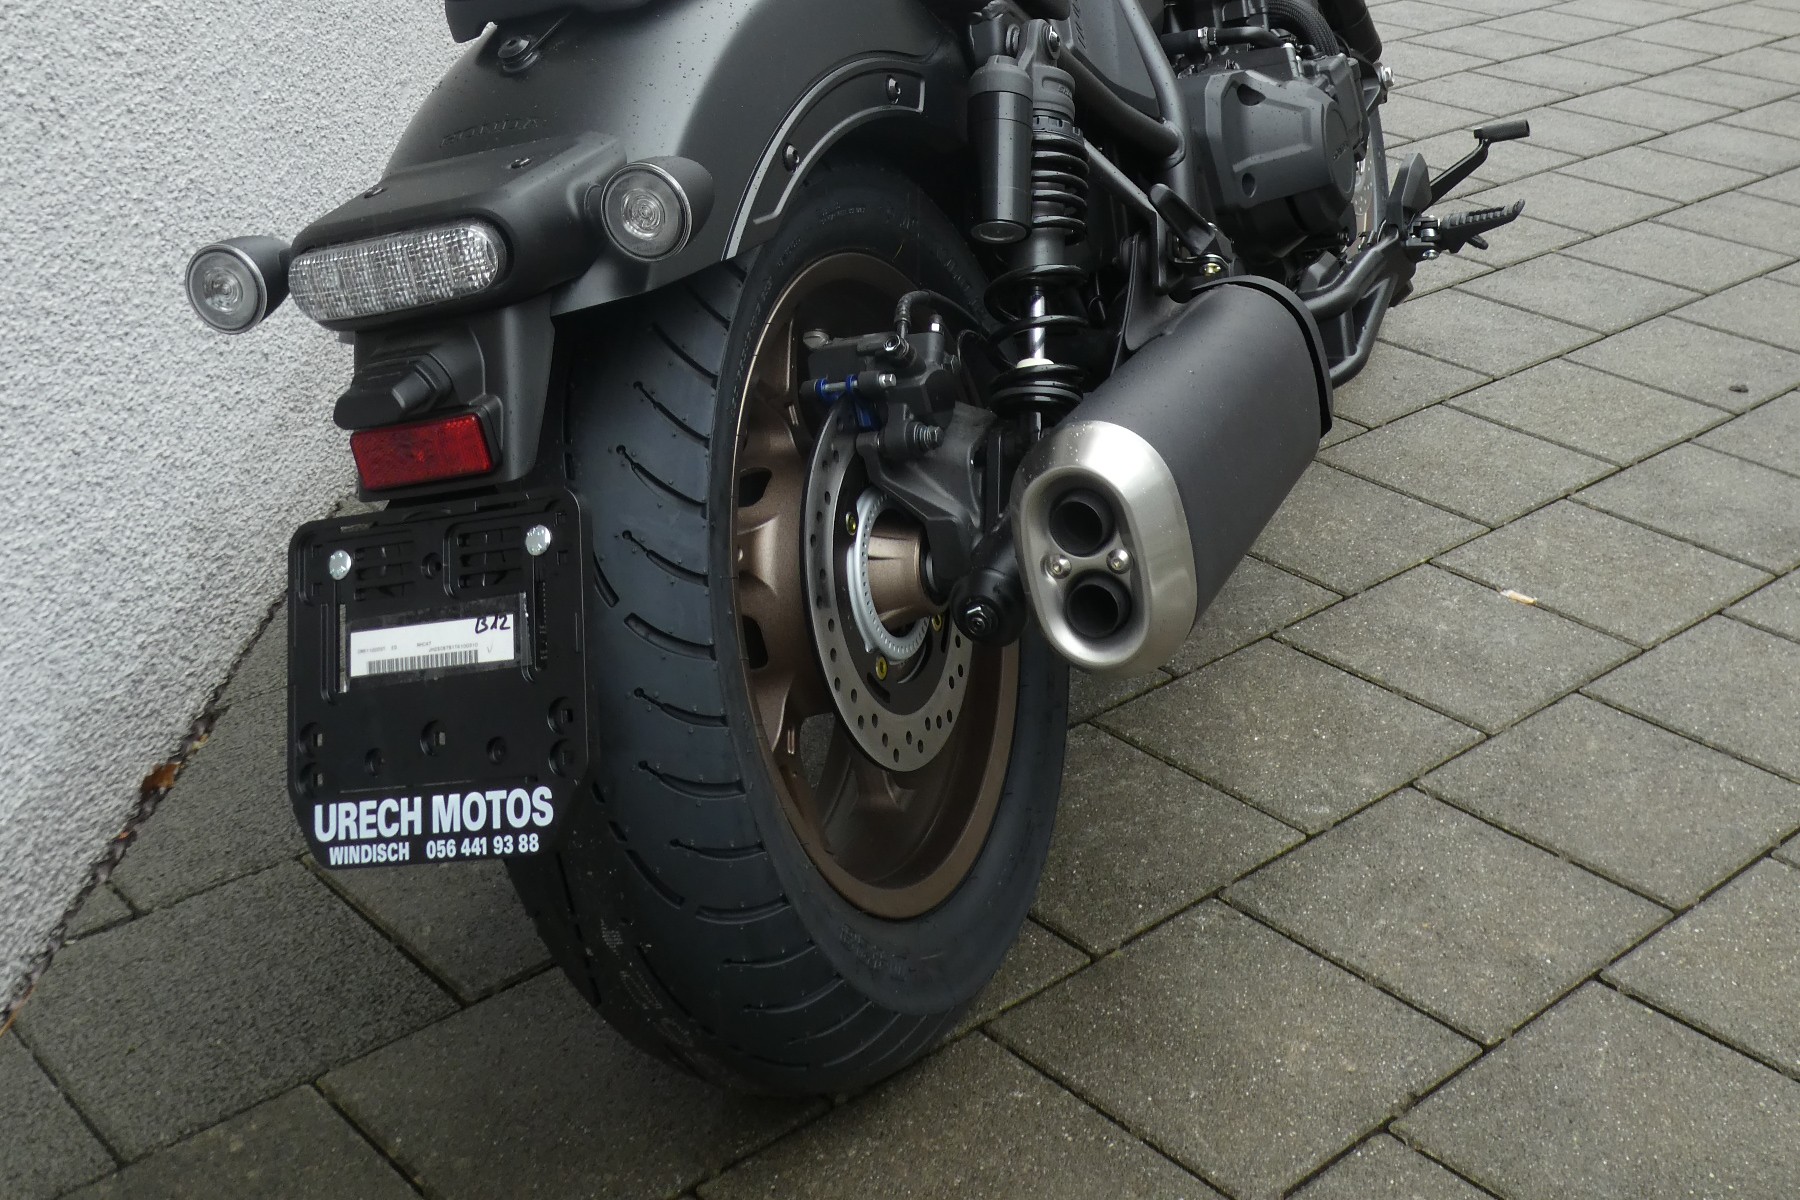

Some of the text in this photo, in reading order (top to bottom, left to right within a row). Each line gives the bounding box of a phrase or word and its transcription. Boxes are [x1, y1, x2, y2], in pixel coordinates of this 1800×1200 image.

[314, 786, 554, 843] URECH MOTOS
[329, 832, 540, 866] WINDISCH 056 441 93 88
